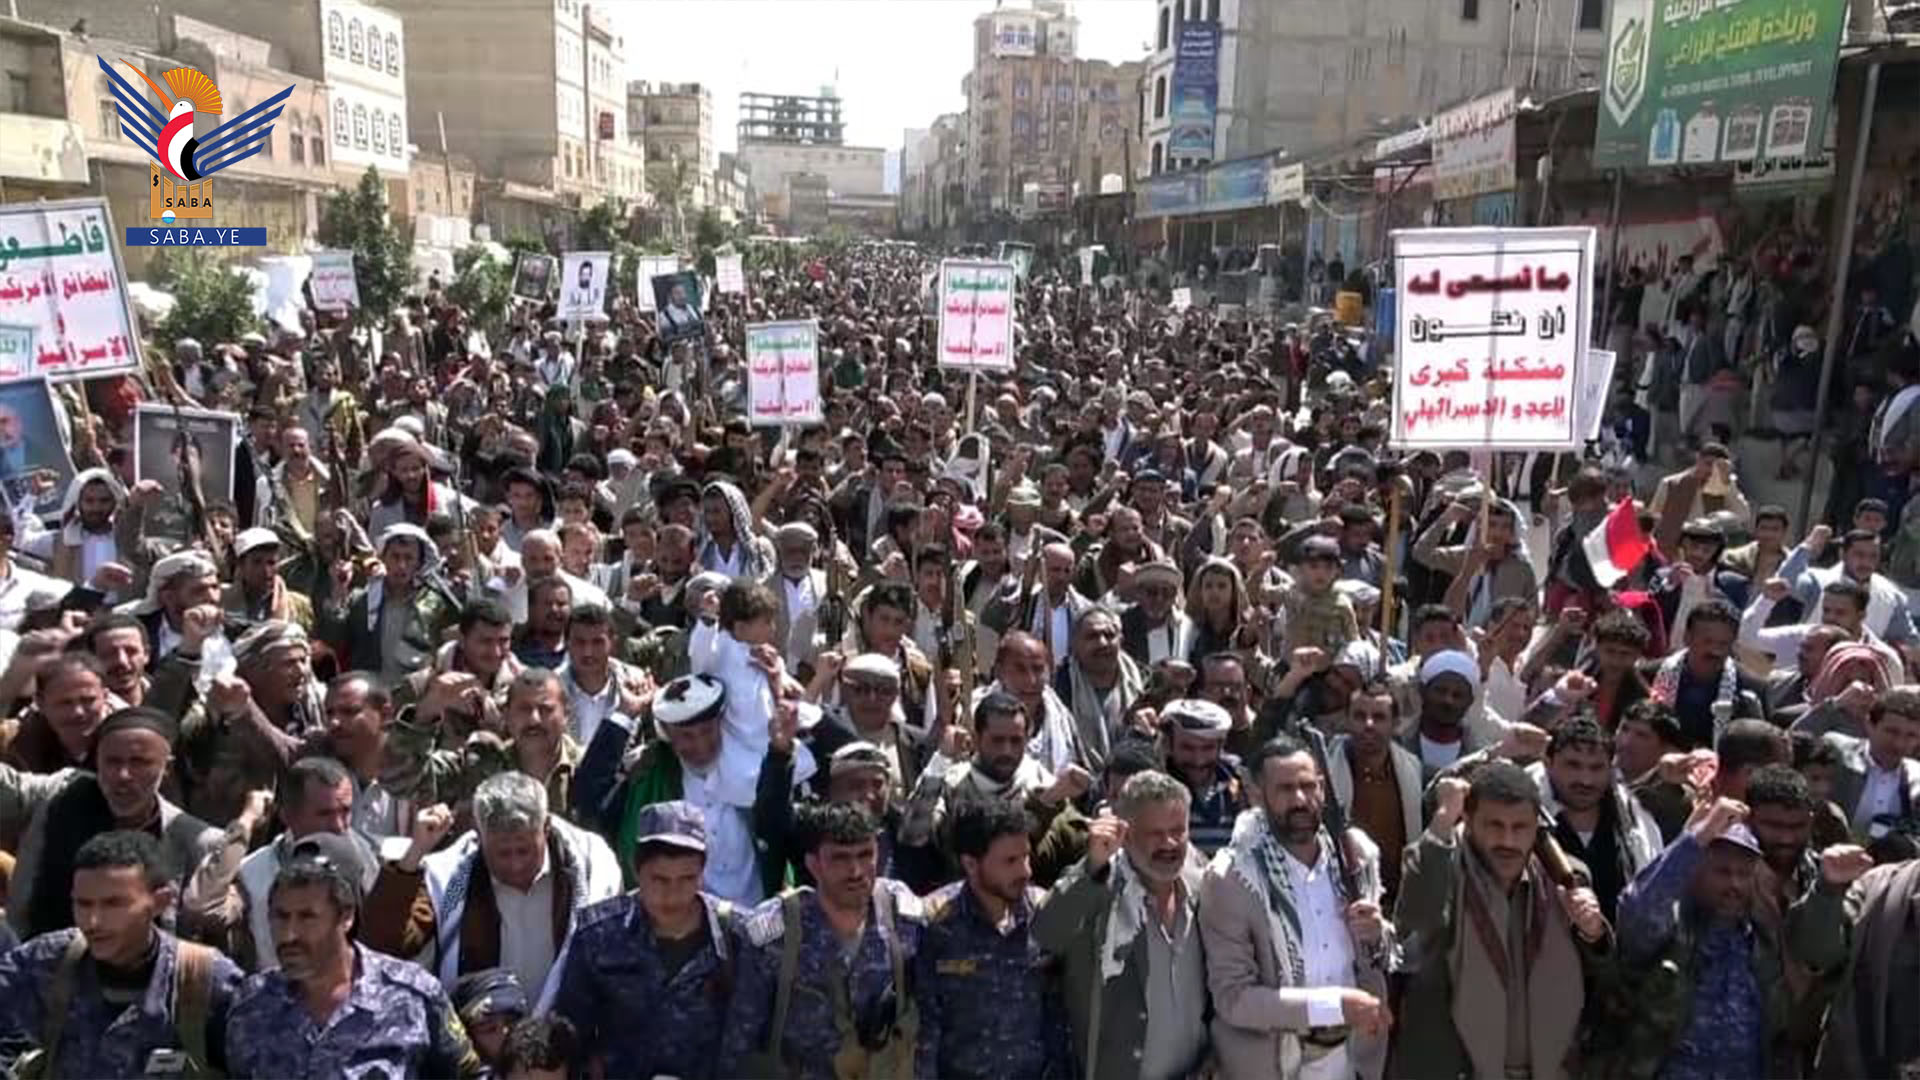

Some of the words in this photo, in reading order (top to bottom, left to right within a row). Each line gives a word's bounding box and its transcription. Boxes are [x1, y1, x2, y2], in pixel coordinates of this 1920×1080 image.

[1408, 269, 1441, 293] له
[1535, 265, 1571, 292] ما
[1537, 305, 1566, 339] أن
[1409, 358, 1470, 387] كبرى
[1482, 356, 1566, 381] مشكلة
[1511, 396, 1566, 419] للعدو
